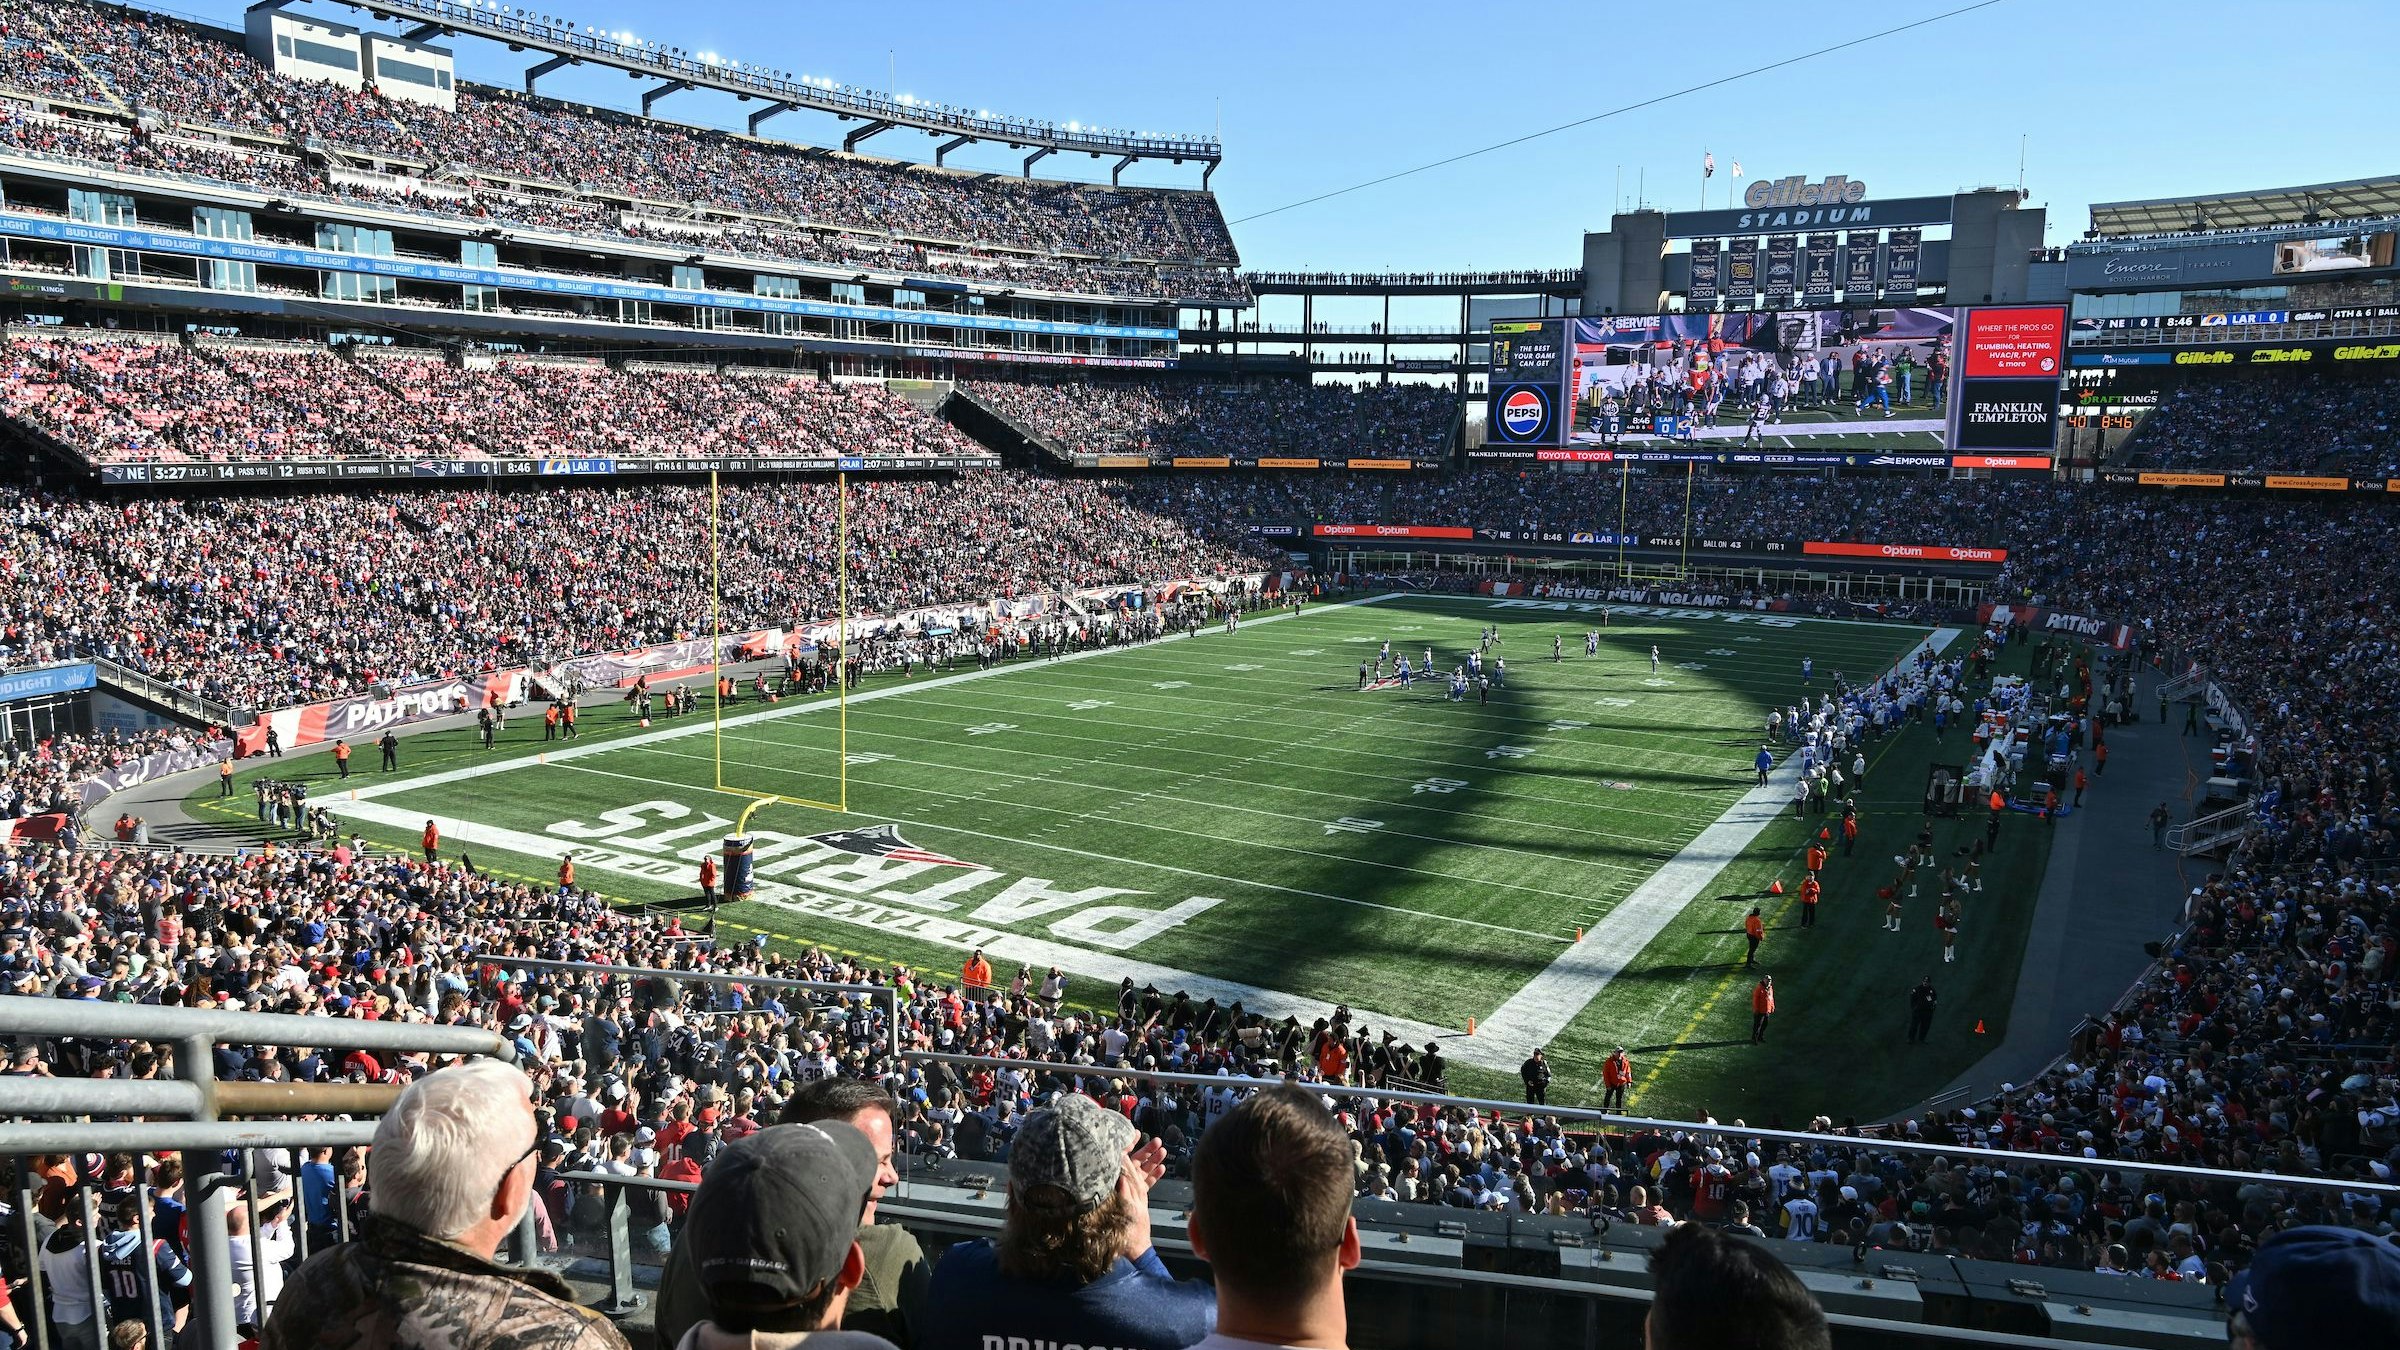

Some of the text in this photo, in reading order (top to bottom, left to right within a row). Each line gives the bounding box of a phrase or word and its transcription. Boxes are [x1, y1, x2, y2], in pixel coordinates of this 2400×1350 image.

[1744, 174, 1866, 209] Gillette
[1738, 207, 1871, 228] STADIUM
[65, 227, 120, 241] BUD LIGHT
[152, 237, 202, 250] BUD LIGHT
[231, 246, 277, 259] BUD LIGHT
[305, 254, 348, 267] BUD LIGHT
[2104, 257, 2178, 275] Encore
[2188, 260, 2232, 268] TERRACE
[374, 262, 415, 274] BUD LIGHT
[439, 270, 477, 280] BUD LIGHT
[2294, 312, 2326, 321] Gillette
[2334, 308, 2371, 318] 4TH & 6
[2378, 307, 2399, 316] BALL
[1615, 316, 1661, 329] SERVICE
[2109, 318, 2147, 328] NE 0
[2167, 317, 2193, 326] 8:46
[2232, 312, 2277, 324] LAR 0
[2041, 323, 2055, 331] GO
[2017, 342, 2052, 350] HEATING,
[996, 353, 1073, 365] NEW ENGLAND PATRIOTS
[1989, 351, 2021, 359] HVAC/R,
[2175, 350, 2235, 365] Gillette
[1085, 357, 1166, 368] NEW ENGLAND PATRIOTS
[2080, 395, 2158, 406] DRAFTKINGS
[1507, 408, 1540, 418] PEPSI
[1975, 402, 2043, 413] FRANKLIN
[1632, 417, 1650, 425] 8:46
[1968, 413, 2048, 423] TEMPLETON
[2068, 416, 2087, 428] 40
[2101, 416, 2133, 429] 8:46
[1610, 423, 1619, 433] 0
[1661, 423, 1670, 433] 0
[1537, 452, 1572, 460] TOYOTA
[1577, 452, 1611, 460] TOYOTA
[1895, 457, 1945, 466] EMPOWER
[451, 462, 489, 473] NE 0
[507, 462, 531, 473] 8:46
[573, 461, 606, 472] LAR 0
[654, 461, 682, 471] 4TH & 6
[687, 461, 719, 470] BALL ON 43
[730, 461, 741, 470] QTR
[848, 460, 935, 468] LAR 2:07 38 7
[1984, 457, 2017, 467] Optum
[126, 468, 146, 480] NE
[154, 467, 208, 480] 3:27 T.O.P.
[218, 466, 268, 478] 14 PASS YDS
[278, 465, 326, 477] 12 RUSH YDS
[336, 464, 379, 476] 1 1ST DOWNS
[388, 463, 395, 475] 1
[1324, 525, 1355, 535] Optum
[1376, 526, 1409, 536] Optum
[1499, 531, 1511, 539] NE
[1543, 533, 1562, 541] 8:46
[1595, 535, 1613, 543] LAR
[1650, 538, 1668, 546] 4TH
[1675, 538, 1681, 546] 6
[1703, 540, 1742, 549] BALL ON 43
[1767, 542, 1779, 551] QTR
[1882, 545, 1922, 557] Optum
[1950, 548, 1992, 559] Optum
[14, 675, 53, 693] LIGHT
[545, 799, 1226, 951] PATRIOTS
[613, 982, 632, 999] 12
[1708, 1183, 1725, 1200] 10
[1795, 1213, 1814, 1238] 10
[109, 1269, 138, 1299] 10
